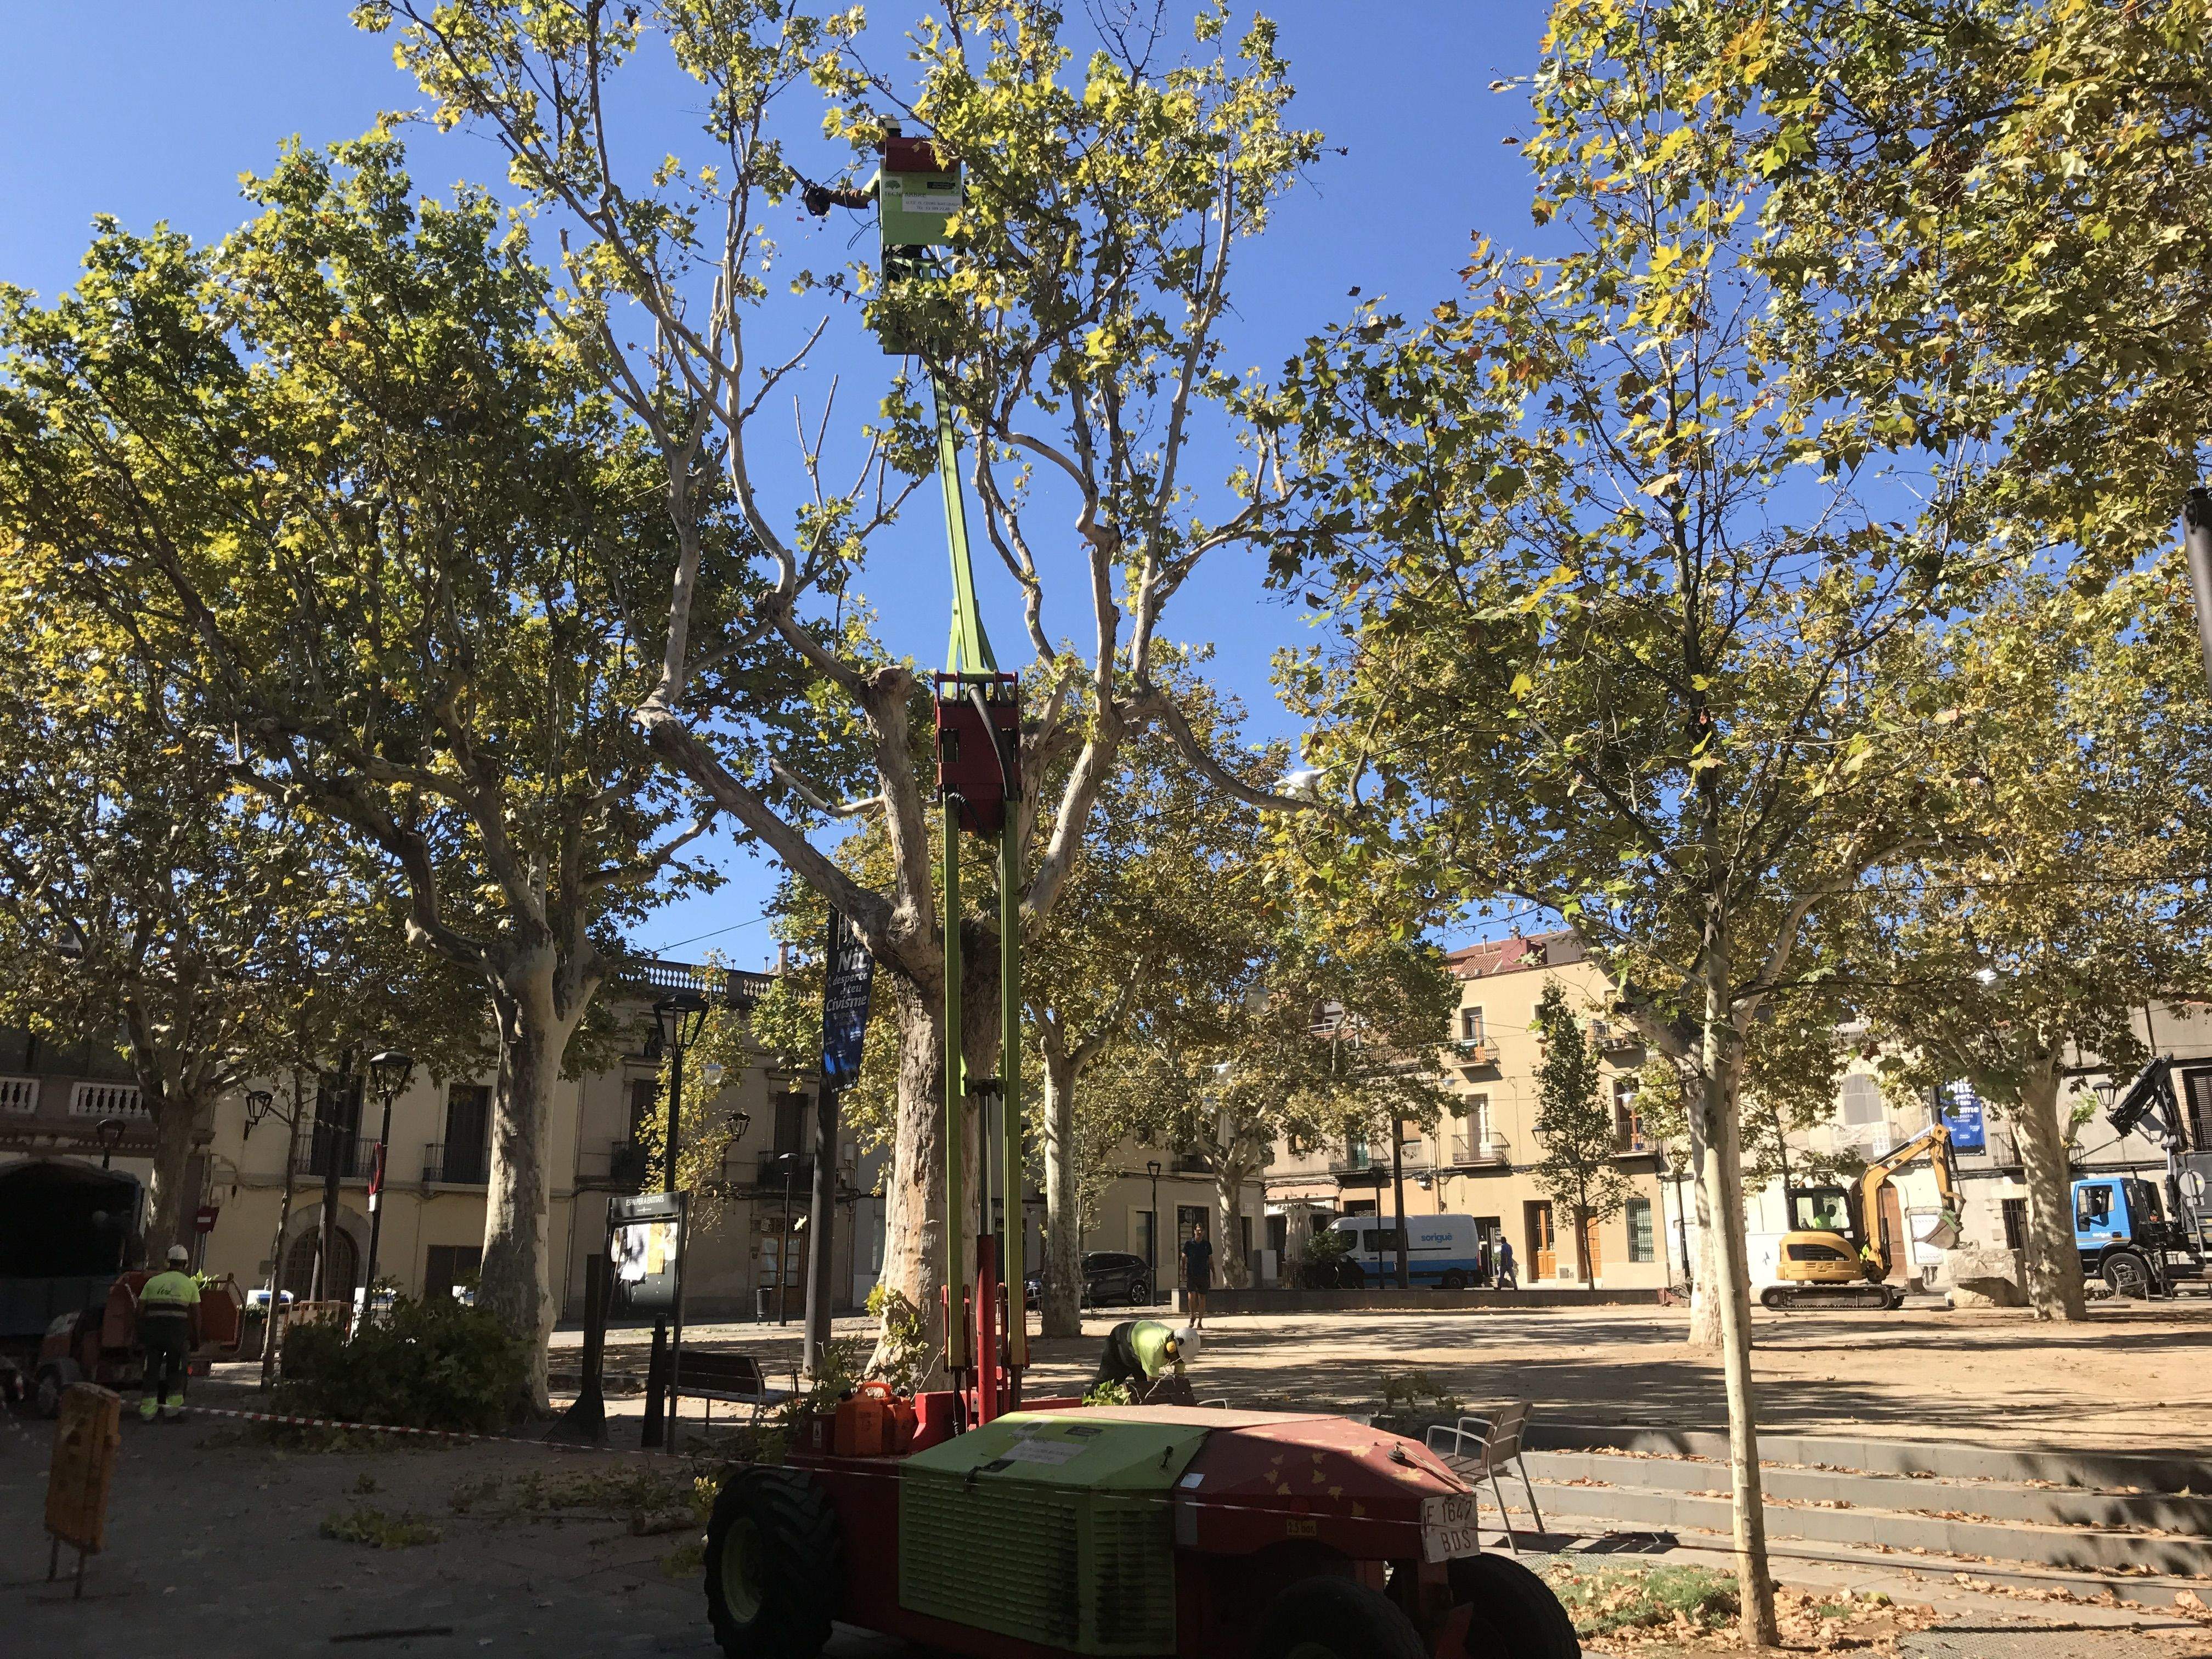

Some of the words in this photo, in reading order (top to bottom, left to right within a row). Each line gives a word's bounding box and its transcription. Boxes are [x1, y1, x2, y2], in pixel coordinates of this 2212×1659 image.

[833, 972, 868, 986] desperta
[847, 985, 862, 994] teu
[826, 995, 867, 1012] Civisme
[647, 1195, 664, 1204] ENTITATS
[1441, 1500, 1472, 1523] 1647
[1440, 1529, 1471, 1553] BDS
